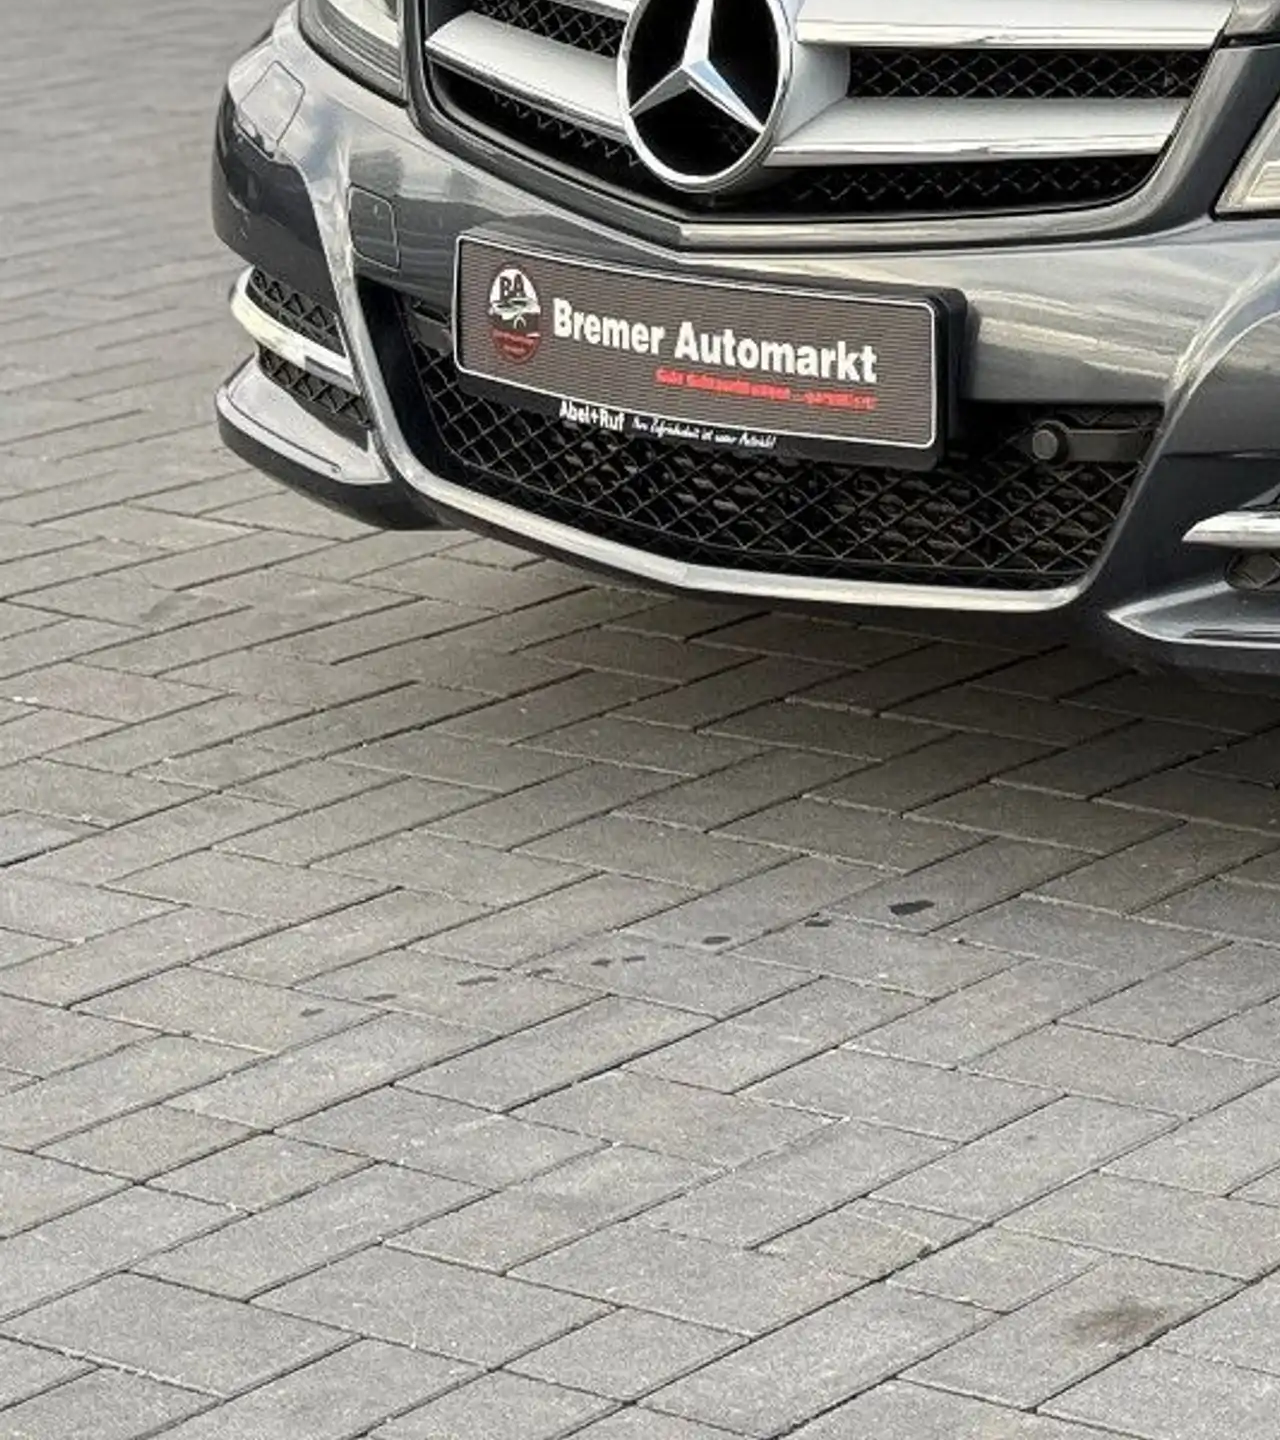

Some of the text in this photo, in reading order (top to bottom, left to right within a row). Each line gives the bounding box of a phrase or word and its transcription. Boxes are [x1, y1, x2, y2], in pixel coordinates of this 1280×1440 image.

[553, 297, 666, 356] Bremer
[673, 320, 878, 384] Automarkt
[559, 400, 626, 432] Abel+Ruf
